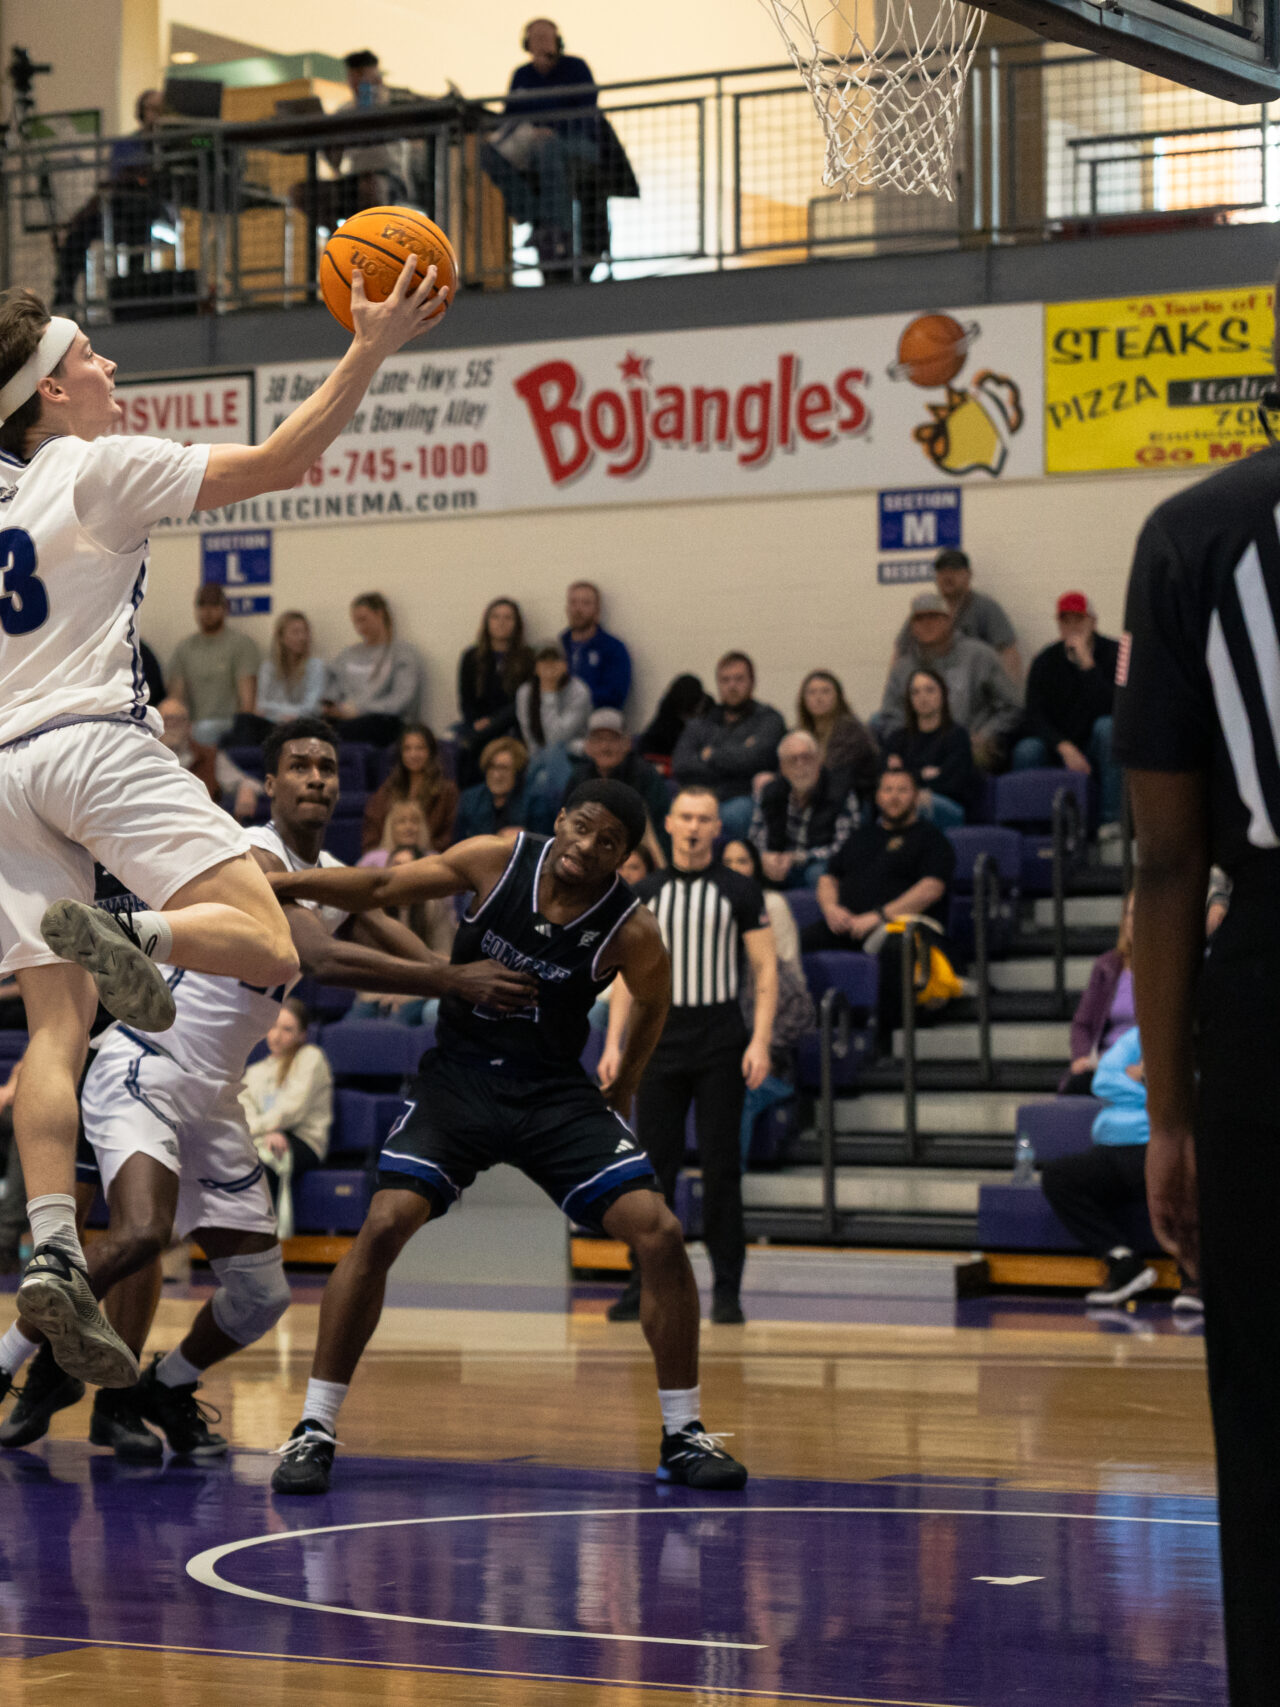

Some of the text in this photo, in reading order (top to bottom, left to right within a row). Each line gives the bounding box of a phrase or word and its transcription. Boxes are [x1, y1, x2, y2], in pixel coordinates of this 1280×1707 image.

[1050, 316, 1251, 364] STEAKS
[113, 389, 239, 434] RSVILLE
[371, 403, 440, 435] Bowling
[442, 399, 488, 429] Alley
[513, 351, 869, 487] Bojangles
[1047, 375, 1277, 430] PIZZA Italia
[296, 441, 489, 488] 6-745-1000
[157, 489, 478, 527] SVILLECINEMA.com
[883, 492, 956, 512] SECTION
[903, 511, 937, 546] M
[227, 553, 246, 583] L
[883, 563, 934, 580] RESER
